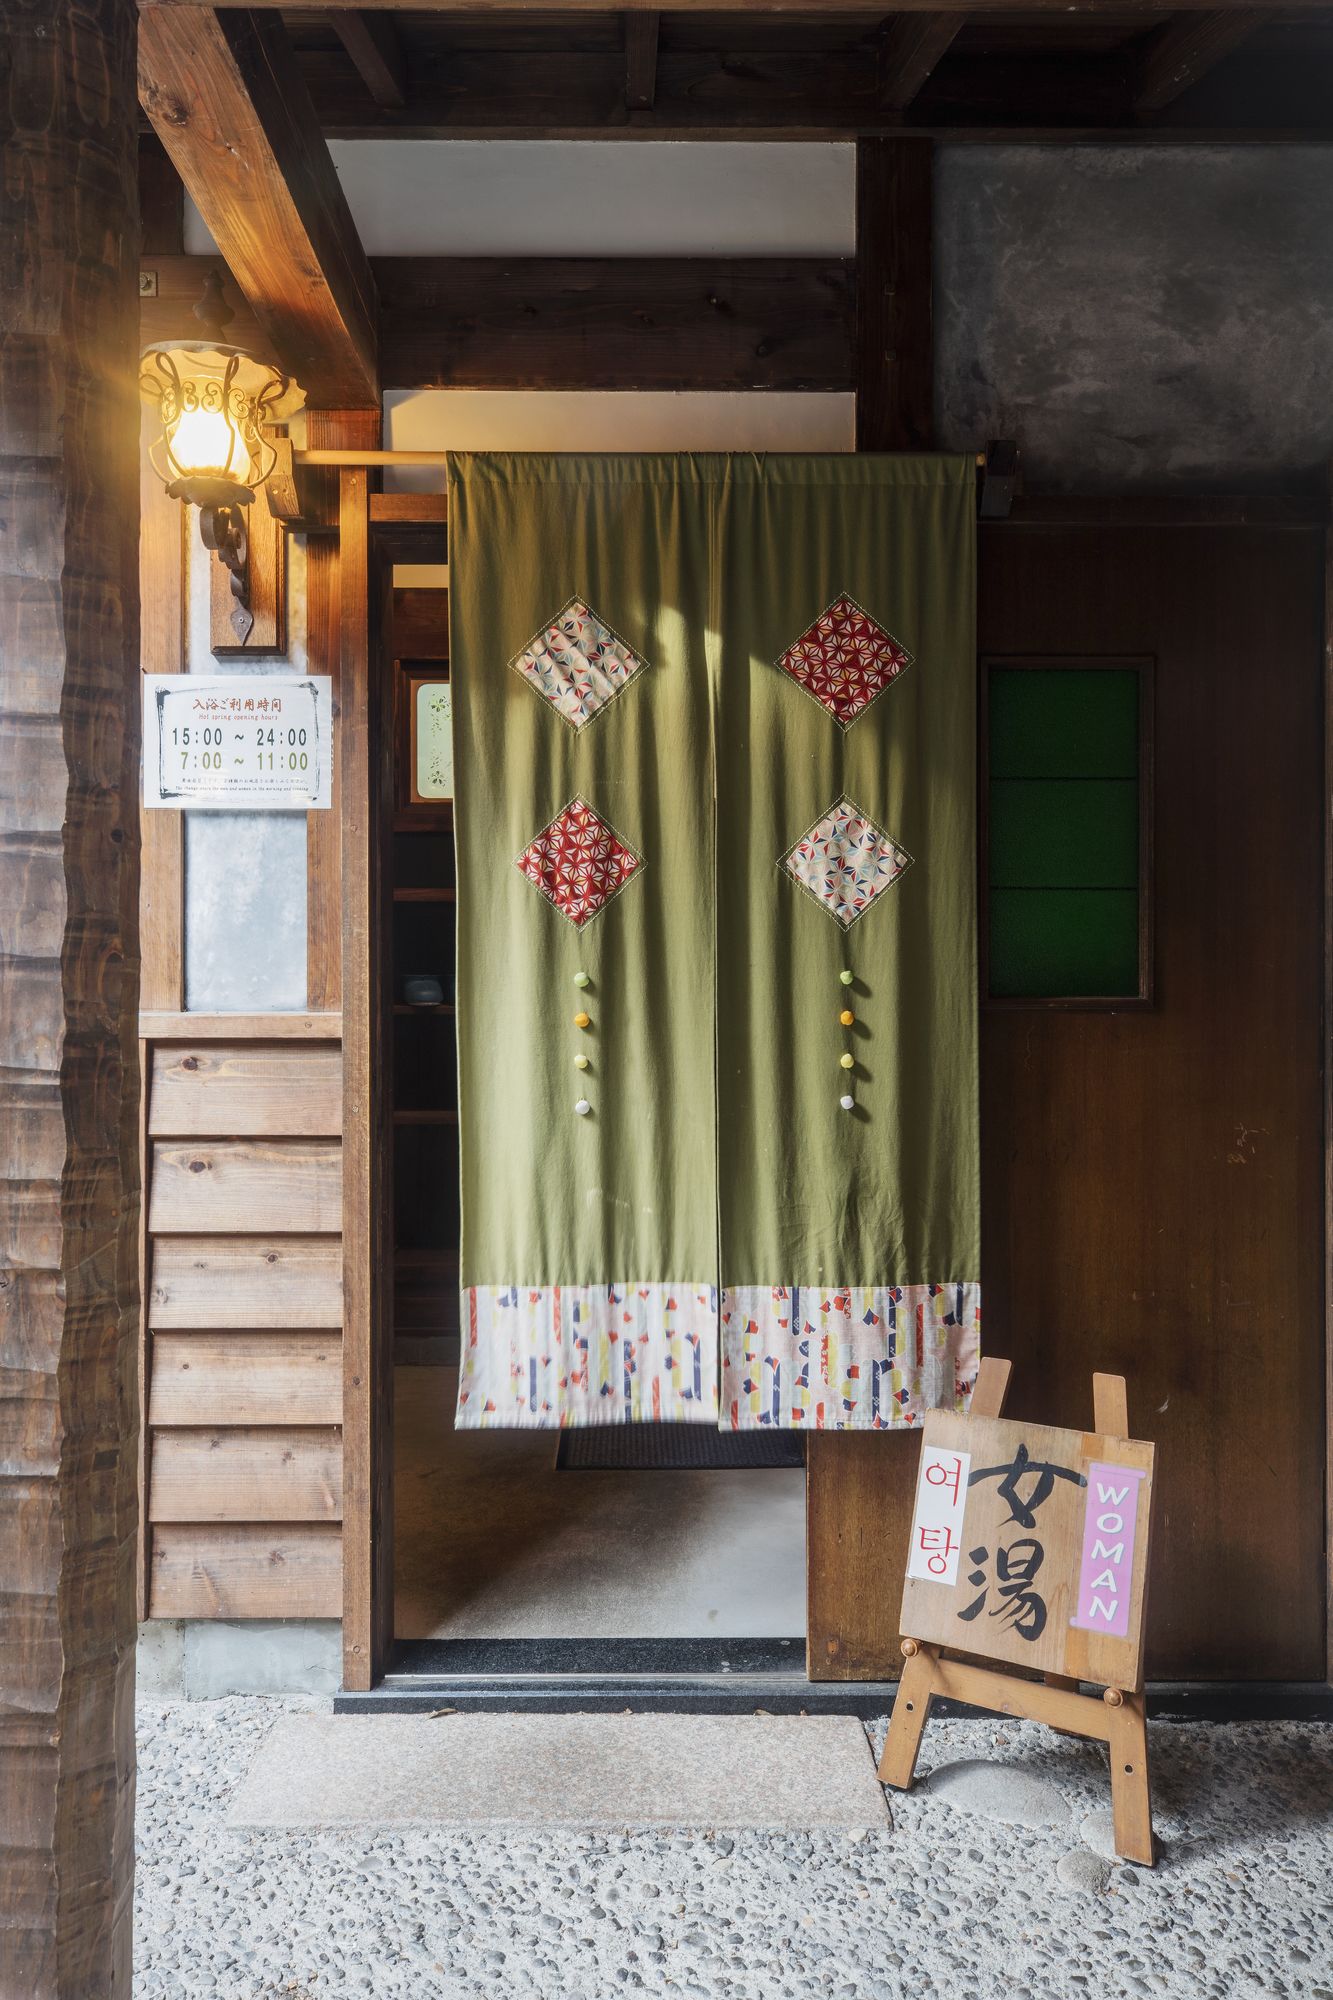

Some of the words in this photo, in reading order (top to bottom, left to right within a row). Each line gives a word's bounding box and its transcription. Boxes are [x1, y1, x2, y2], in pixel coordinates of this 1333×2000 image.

[172, 728, 222, 746] 15:00
[256, 728, 307, 746] 24:00
[193, 698, 282, 713] 入浴ご利用時間
[180, 752, 222, 770] 7:00
[257, 752, 308, 771] 11:00
[919, 1458, 962, 1574] 여탕
[957, 1443, 1088, 1642] 女湯
[1089, 1482, 1130, 1622] WOMAN
